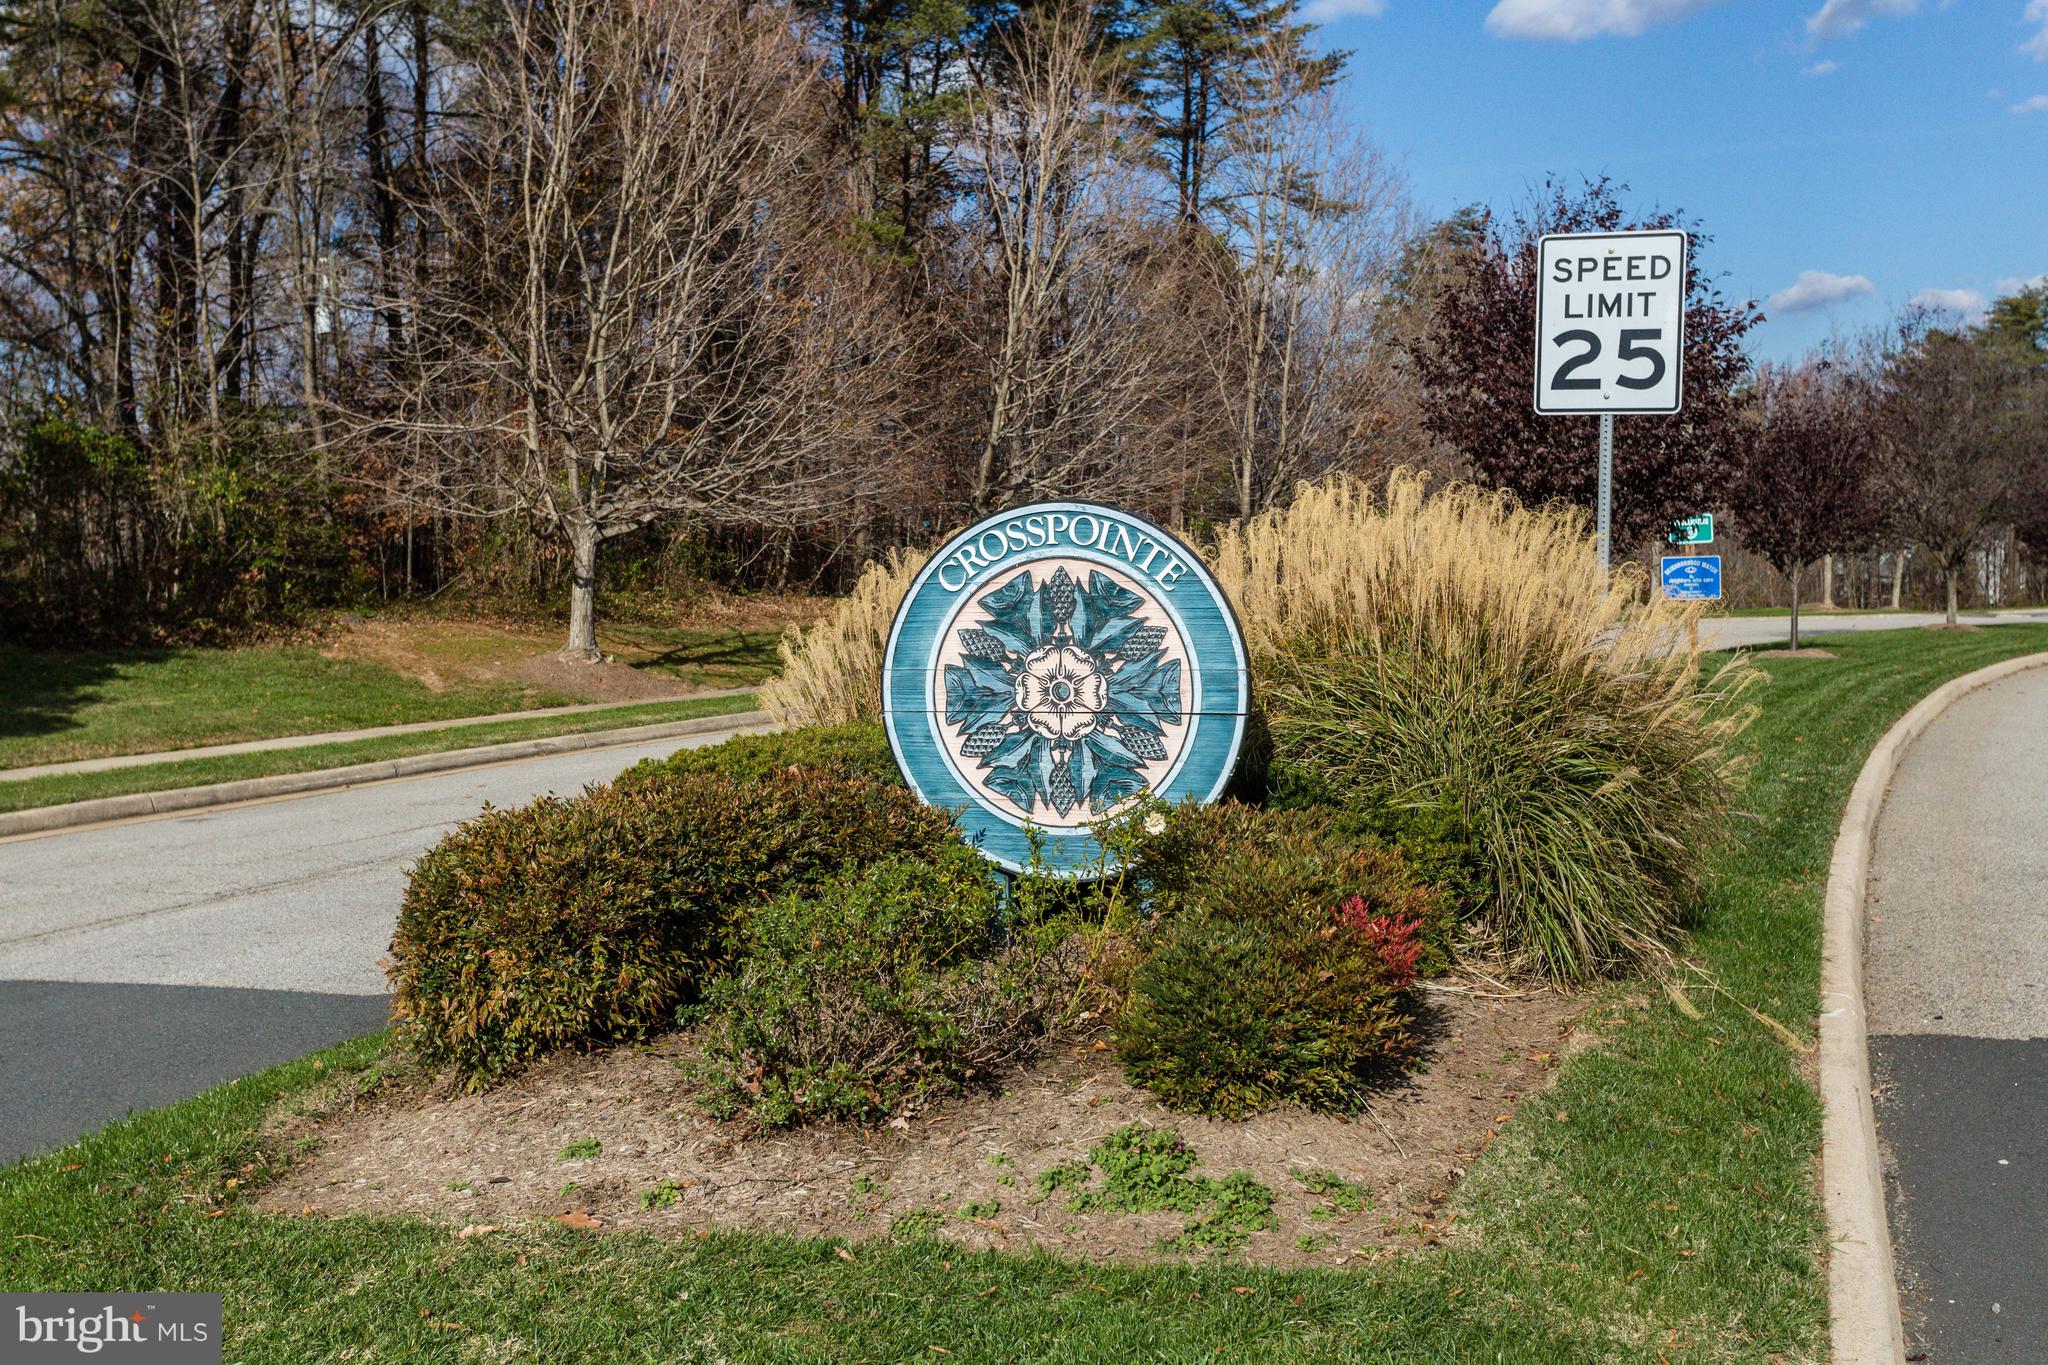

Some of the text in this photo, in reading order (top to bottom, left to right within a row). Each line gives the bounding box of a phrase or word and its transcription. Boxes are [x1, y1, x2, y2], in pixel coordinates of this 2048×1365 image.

[1552, 255, 1671, 283] SPEED
[1564, 291, 1657, 319] LIMIT
[1550, 328, 1666, 391] 25
[938, 513, 1188, 593] CROSSPOINTE
[1701, 561, 1719, 575] WATCH
